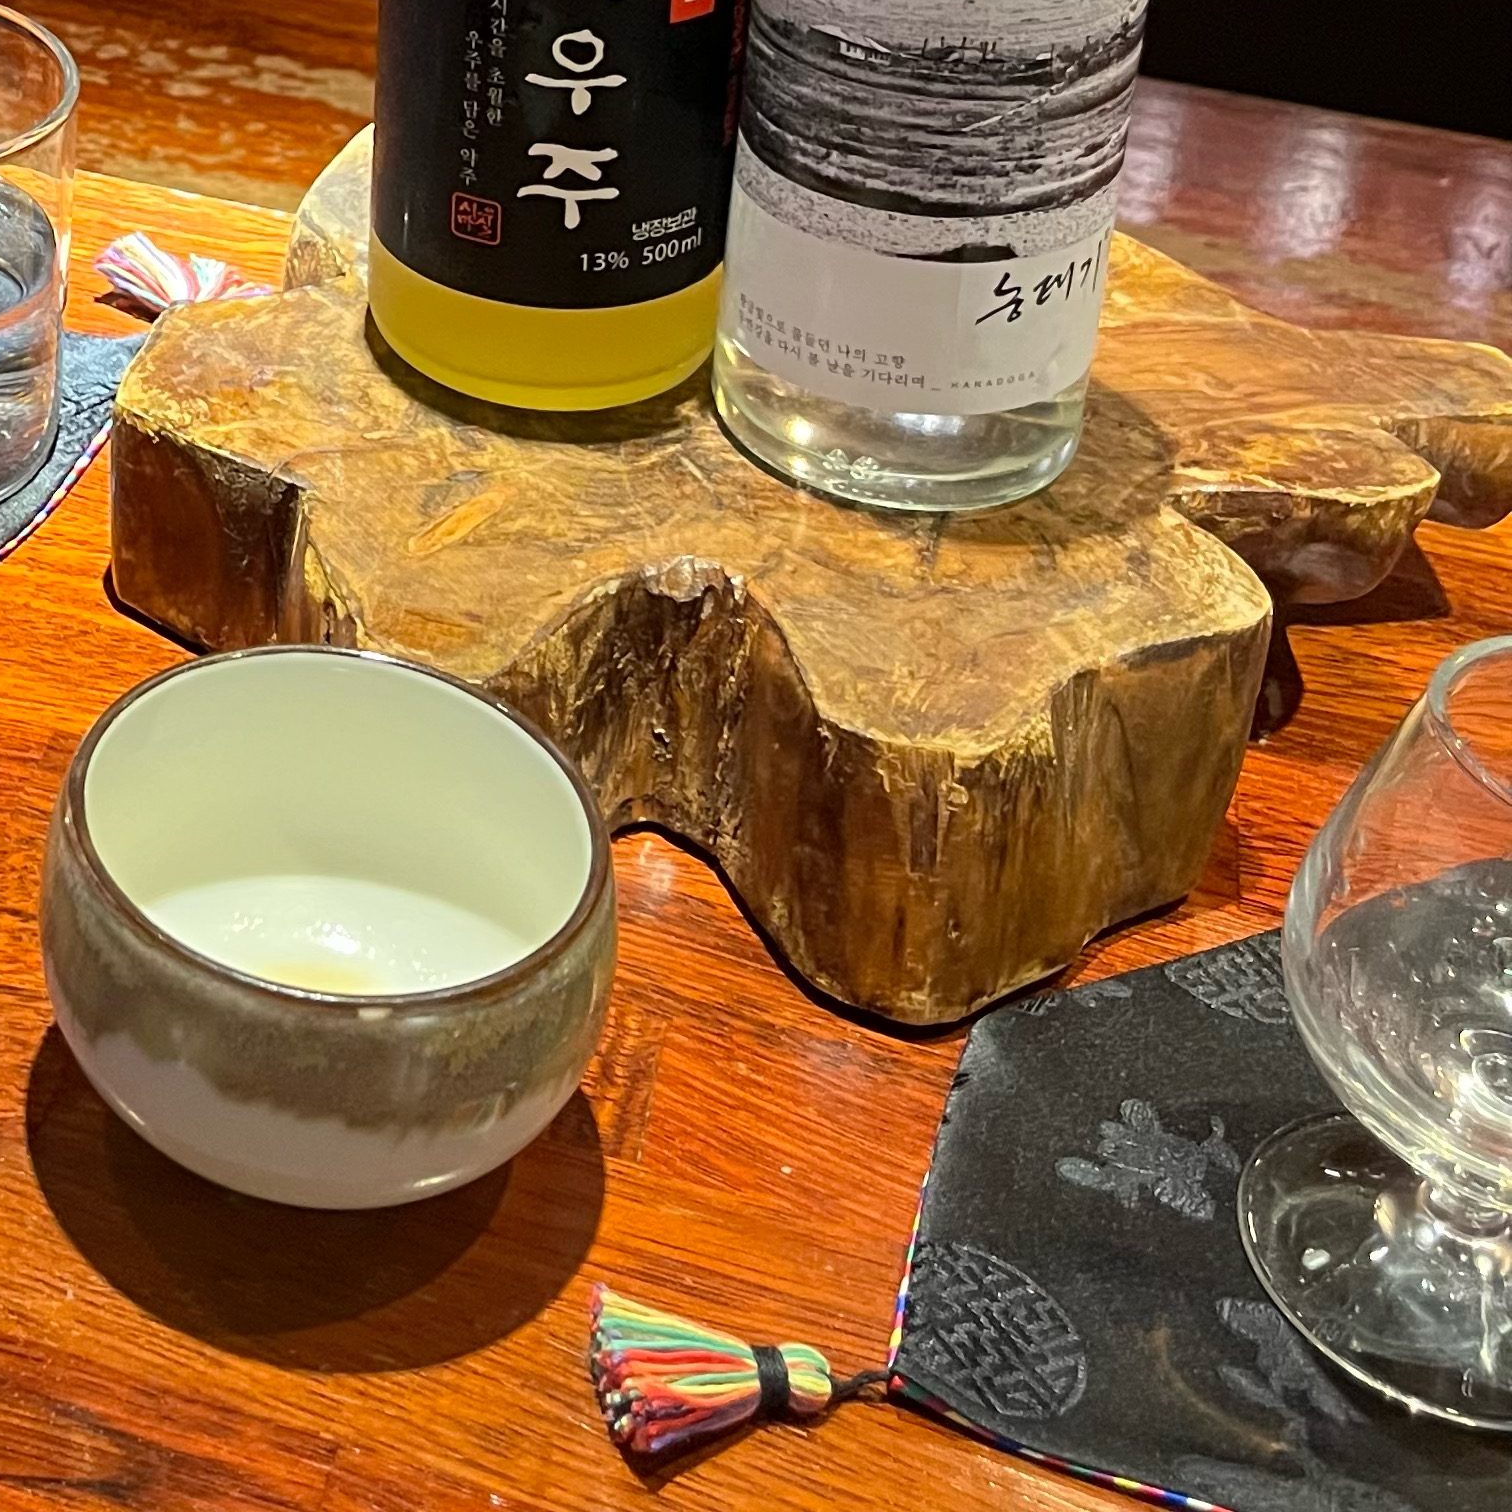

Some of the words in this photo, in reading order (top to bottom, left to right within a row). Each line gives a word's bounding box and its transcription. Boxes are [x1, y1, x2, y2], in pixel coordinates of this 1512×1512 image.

[631, 206, 697, 241] 냉장보관
[580, 250, 630, 272] 13%
[641, 227, 702, 265] 500ml
[777, 340, 802, 361] 다시
[837, 344, 867, 364] 나의
[873, 352, 906, 370] 고향
